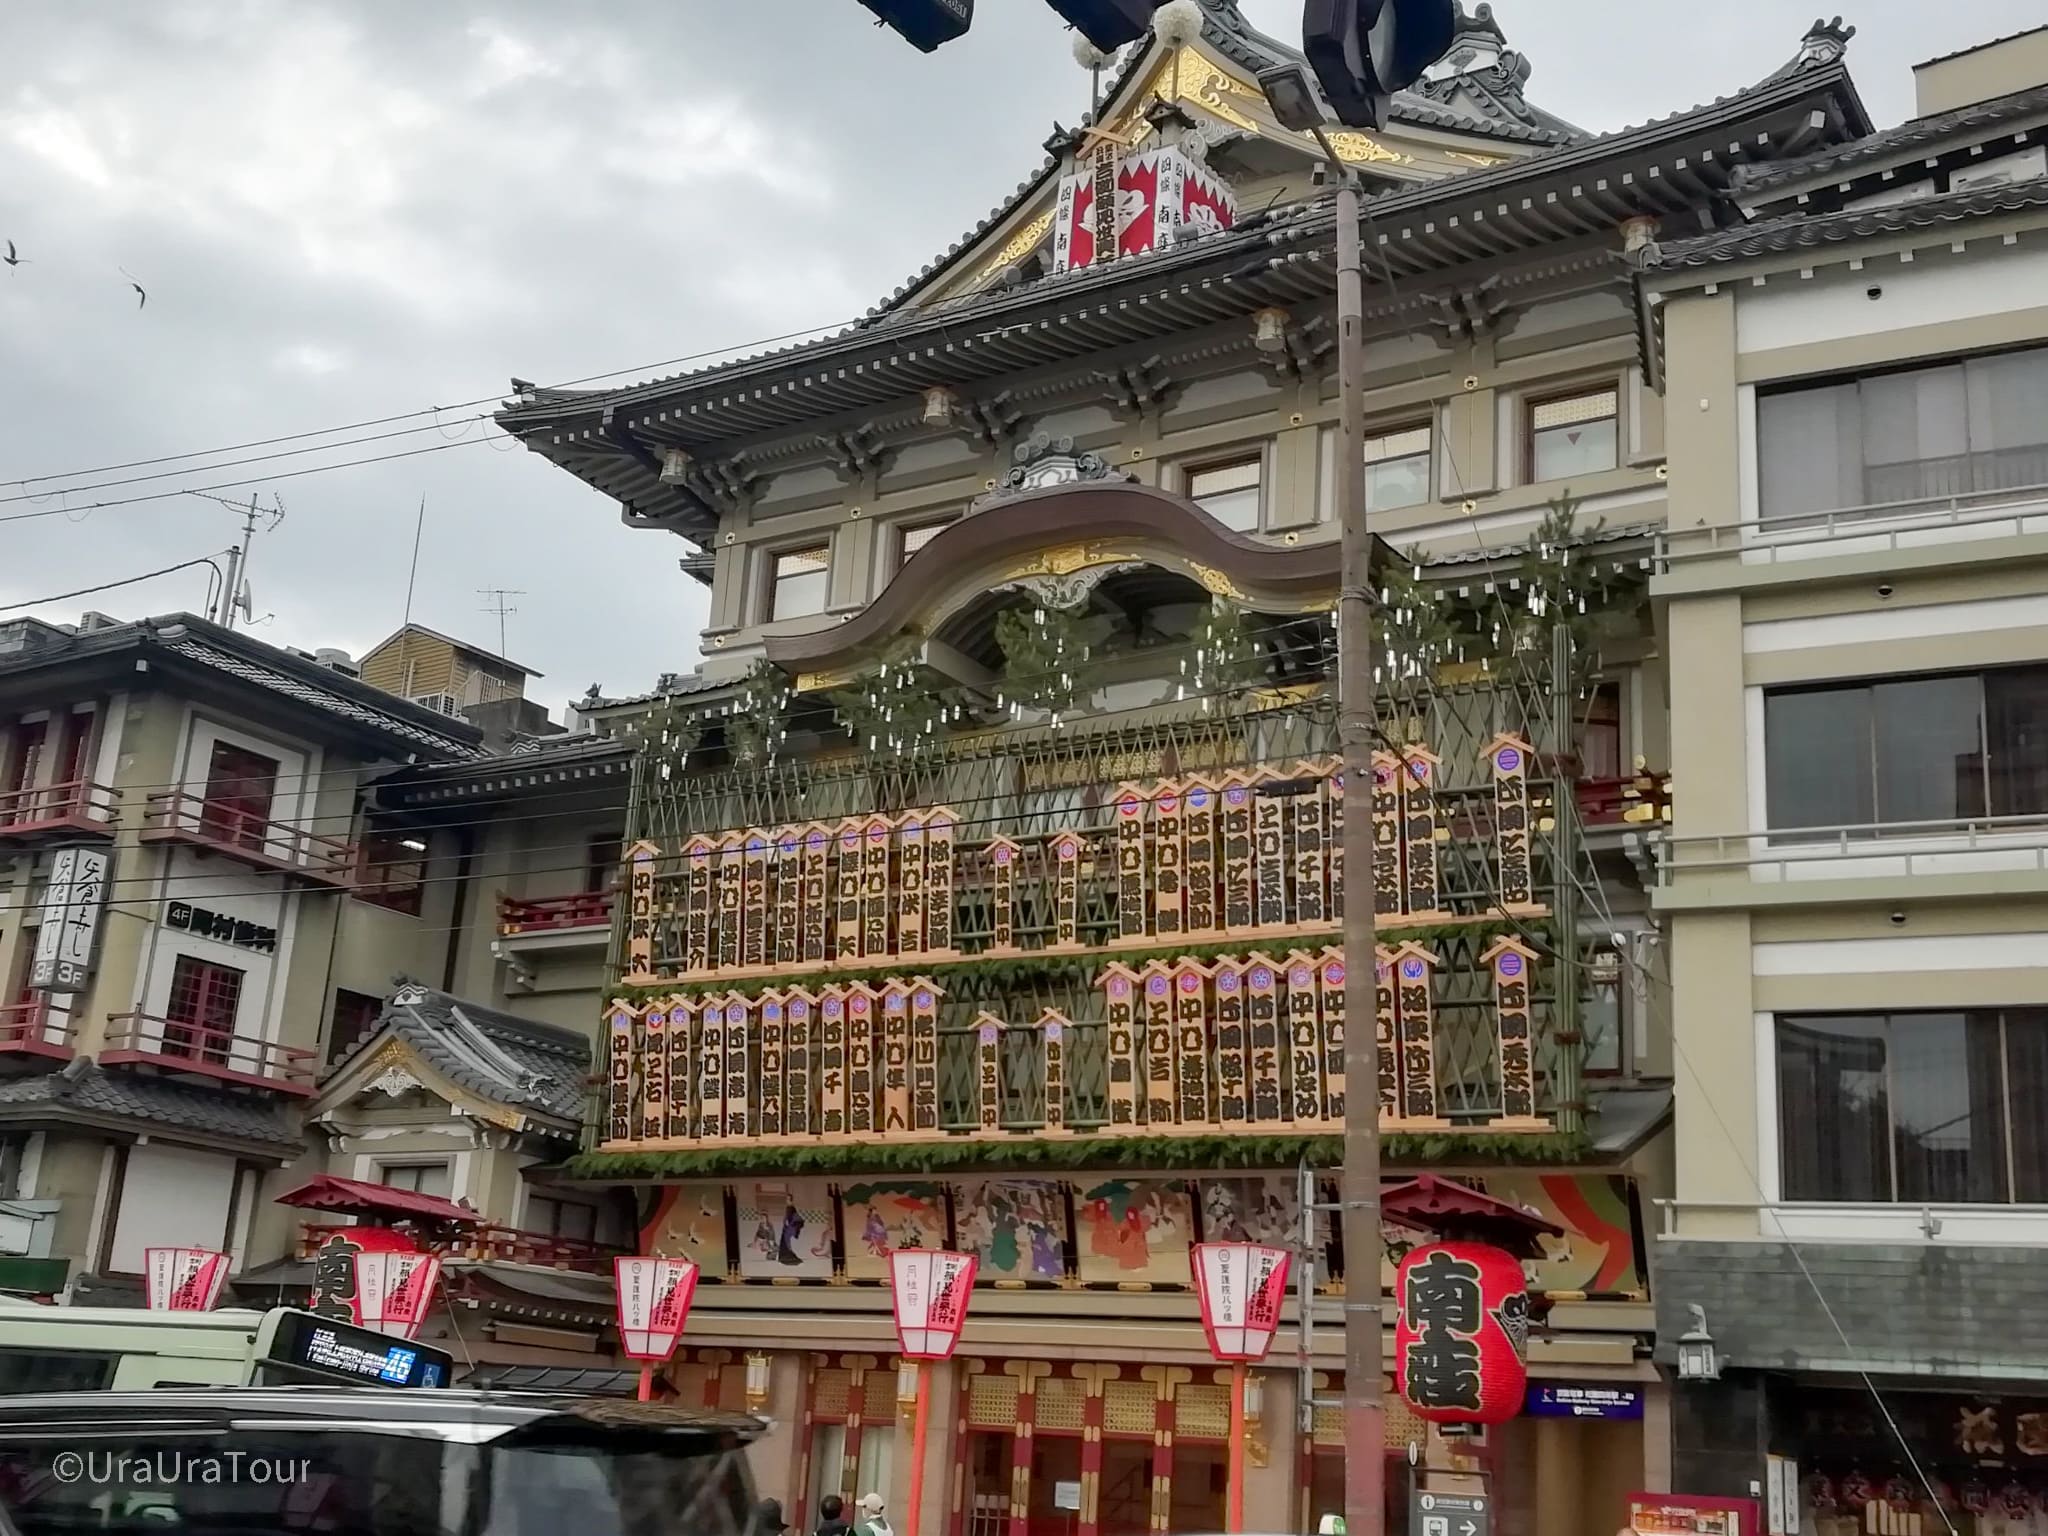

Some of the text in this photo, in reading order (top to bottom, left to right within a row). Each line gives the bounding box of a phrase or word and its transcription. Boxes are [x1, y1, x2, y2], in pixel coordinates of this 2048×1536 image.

[172, 908, 189, 921] 4F
[34, 962, 54, 982] 3F
[58, 962, 82, 984] 3F
[1405, 1251, 1482, 1411] 南座
